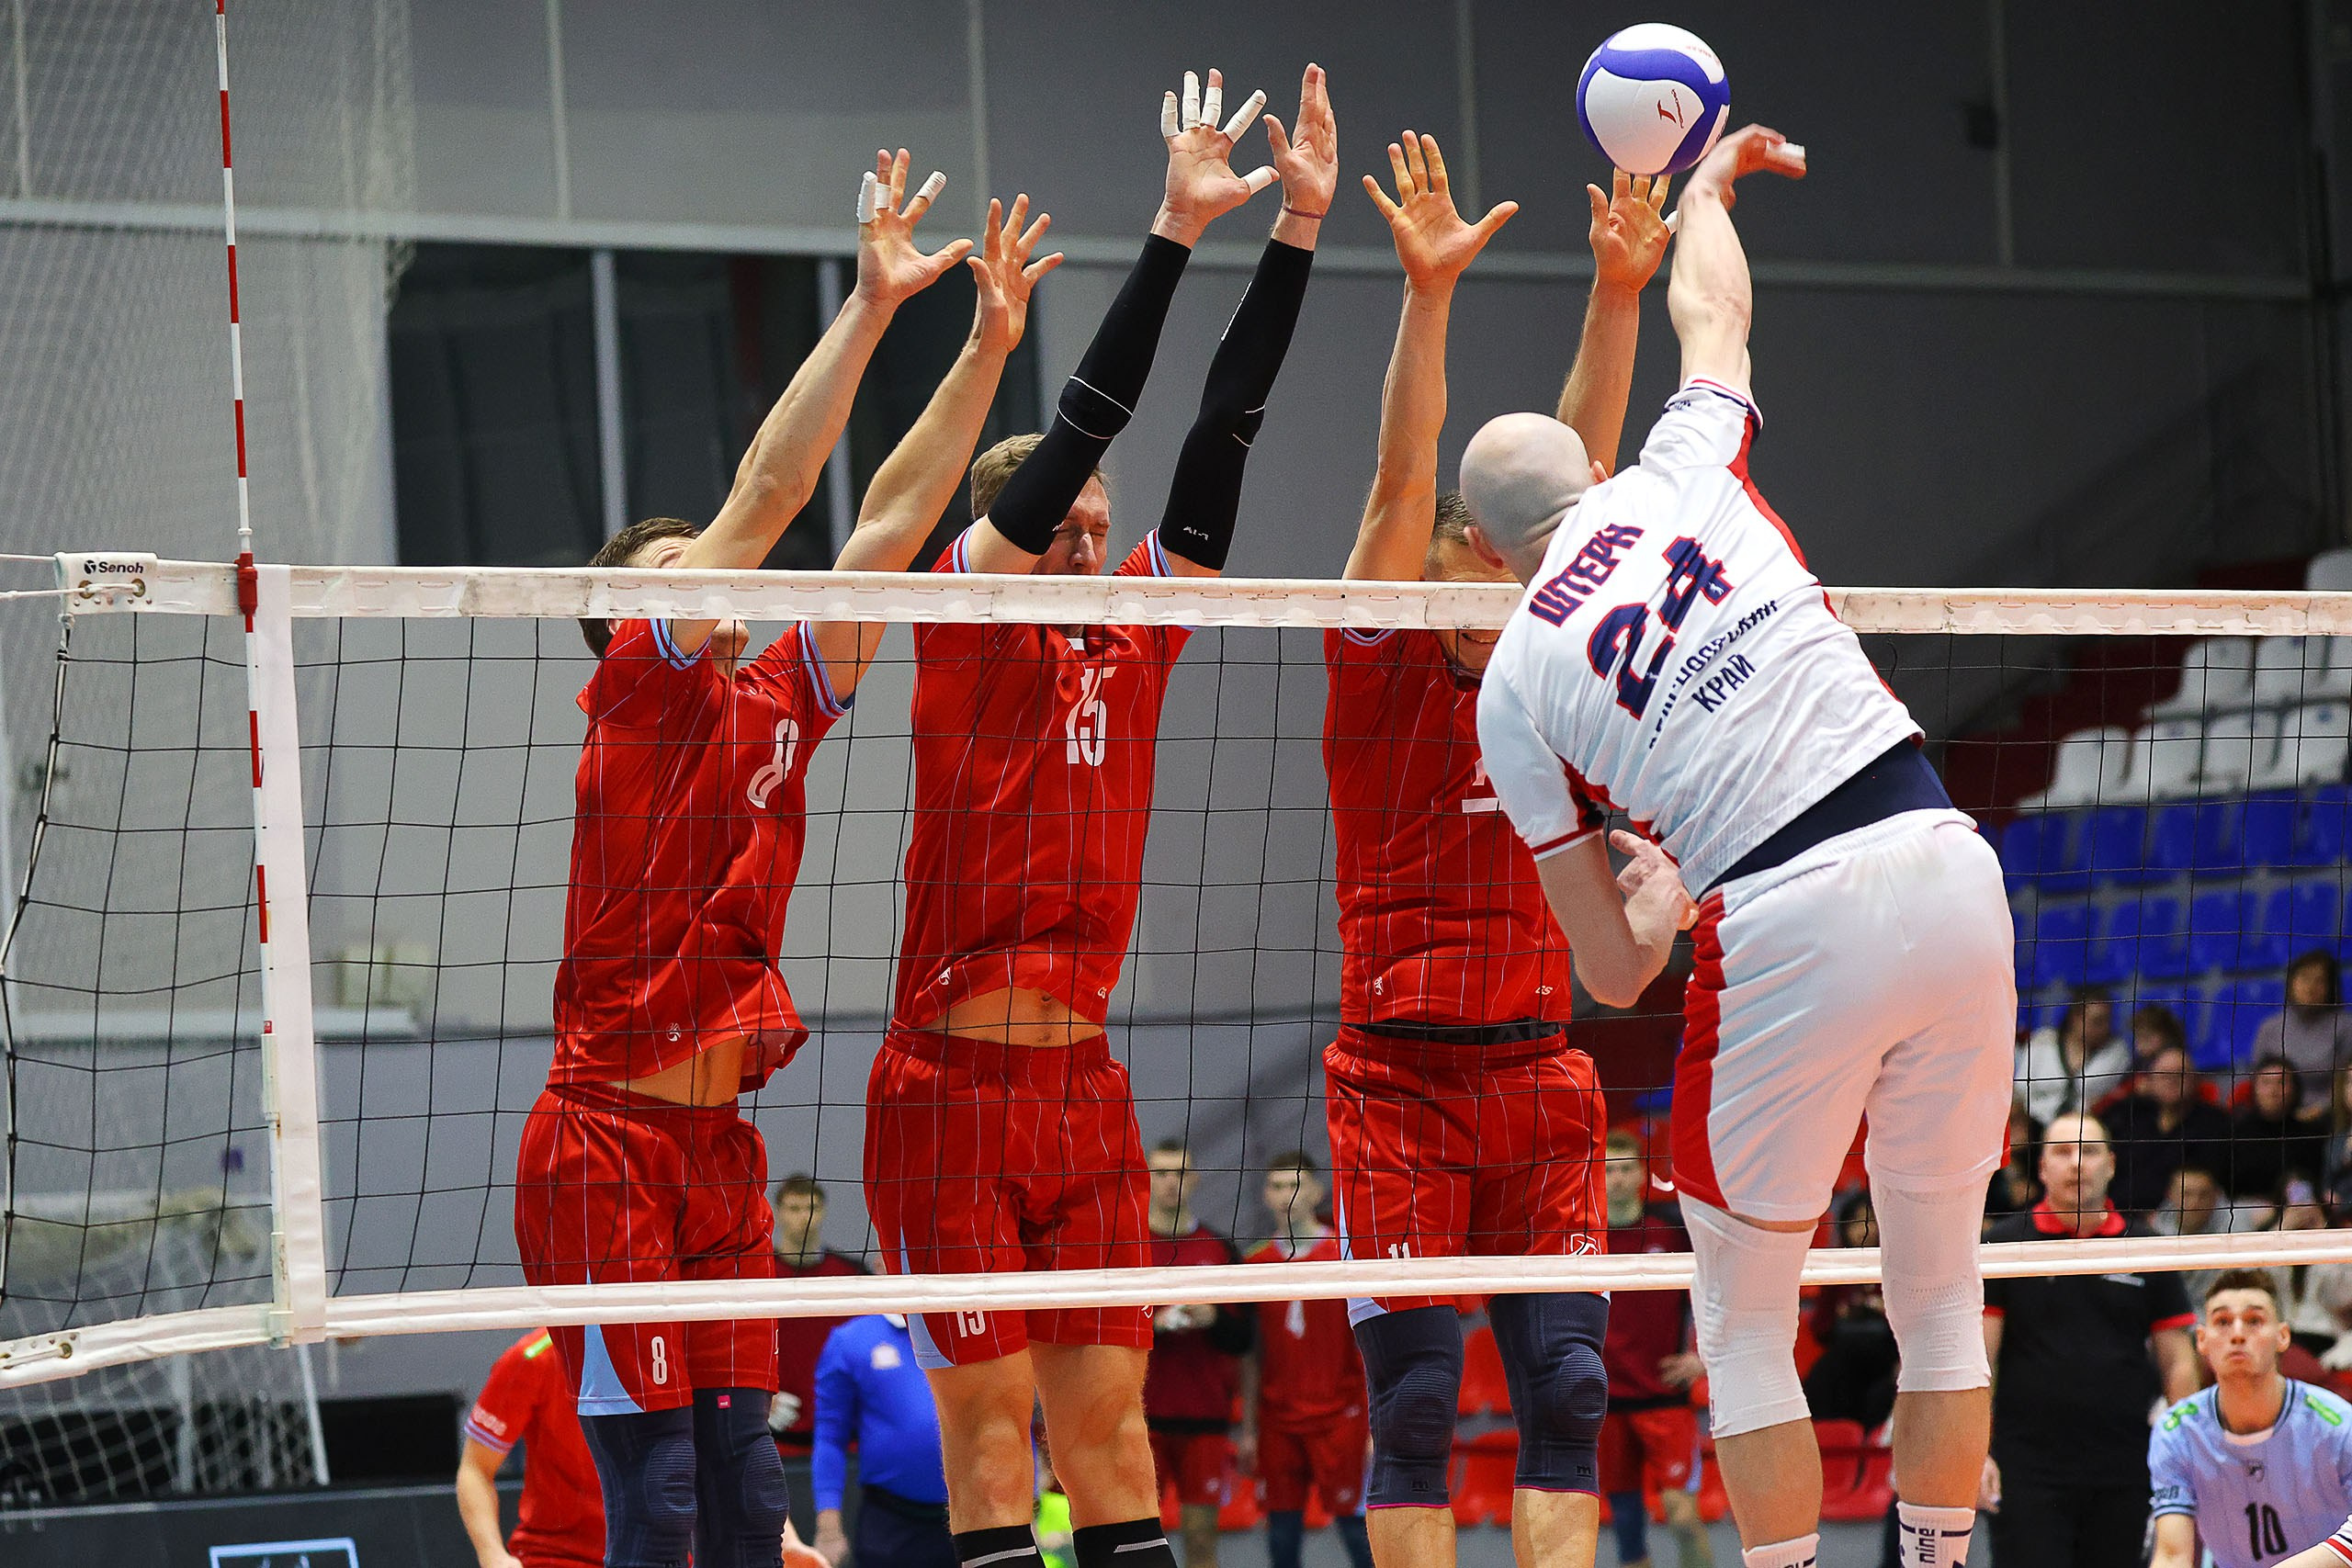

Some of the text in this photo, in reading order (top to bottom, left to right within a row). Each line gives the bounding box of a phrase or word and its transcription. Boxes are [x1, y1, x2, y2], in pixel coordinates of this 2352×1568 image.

[98, 561, 144, 574] Senoh
[1529, 523, 1645, 627] ШТЕРН
[1587, 536, 1735, 721] 24
[1691, 653, 1756, 714] КРАЙ
[1066, 663, 1117, 767] 15
[747, 718, 799, 809] 8
[650, 1336, 668, 1385] 8
[1915, 1528, 1936, 1564] nine
[2245, 1502, 2289, 1562] 10
